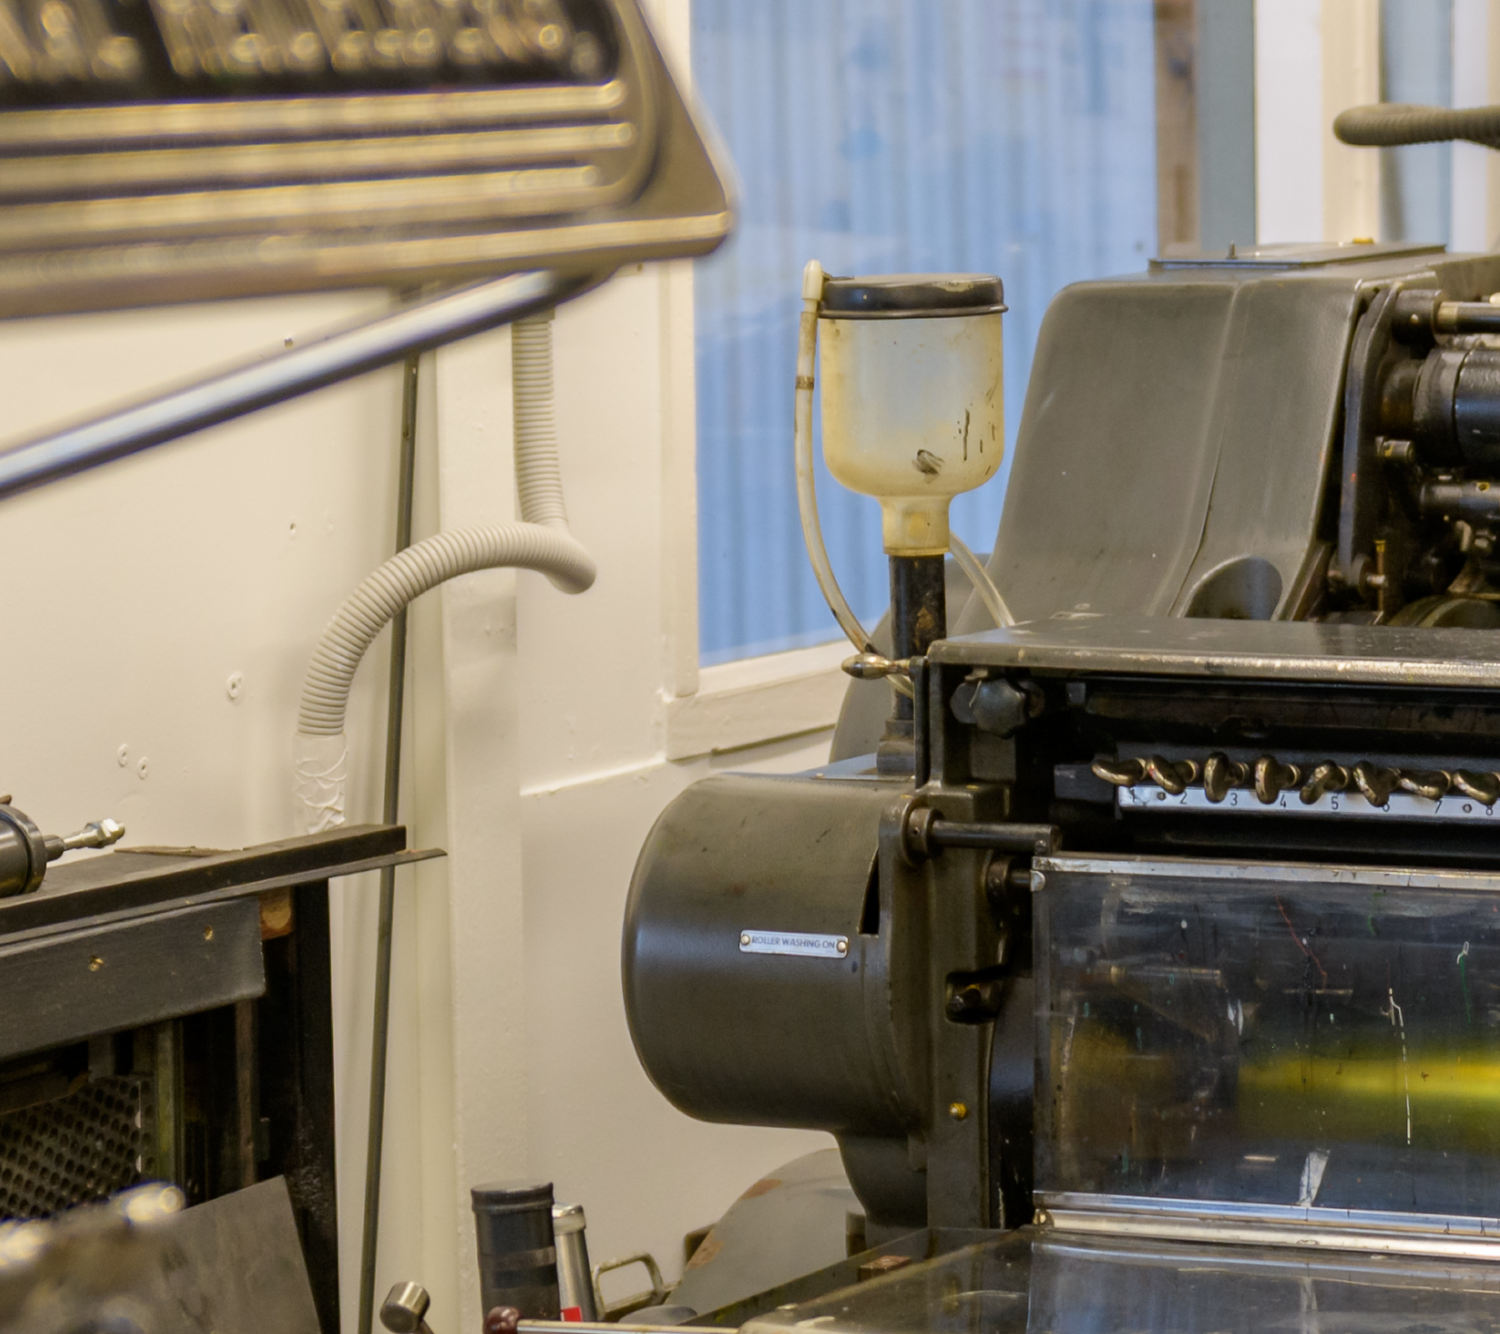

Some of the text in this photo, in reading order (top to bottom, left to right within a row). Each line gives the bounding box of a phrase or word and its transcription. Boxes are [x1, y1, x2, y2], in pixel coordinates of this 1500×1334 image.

[1180, 791, 1187, 805] 2
[1230, 793, 1239, 806] 3
[1279, 794, 1288, 809] 4
[1331, 795, 1339, 811] 5
[1485, 801, 1493, 816] 8
[751, 936, 835, 949] ROLLER WASHING ON
